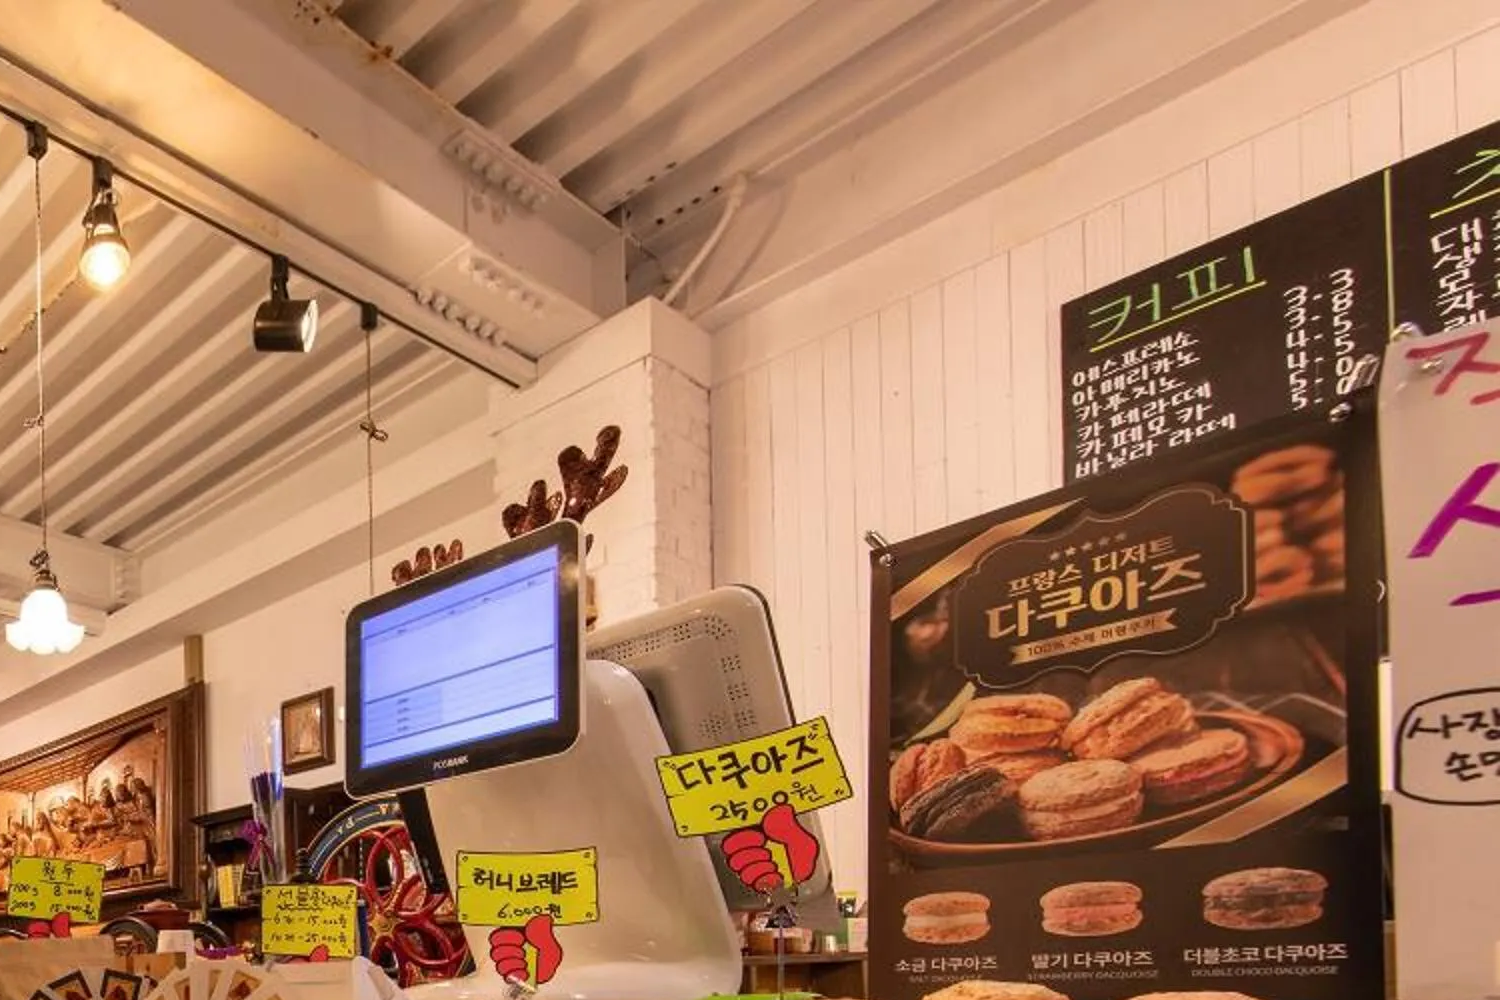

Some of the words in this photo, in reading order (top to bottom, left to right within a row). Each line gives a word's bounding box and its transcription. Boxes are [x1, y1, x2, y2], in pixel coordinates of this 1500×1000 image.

[1089, 246, 1255, 342] 커피
[1008, 563, 1083, 597] 프랑스
[1091, 536, 1177, 573] 디저트
[985, 553, 1207, 639] 다쿠아즈
[676, 736, 825, 790] 다쿠아즈
[709, 781, 825, 821] 2500원
[894, 958, 926, 974] 소금
[1031, 952, 1068, 969] 딸기
[1073, 950, 1155, 969] 다쿠아즈
[1183, 947, 1261, 965] 더블초코
[1264, 943, 1349, 963] 다쿠아즈
